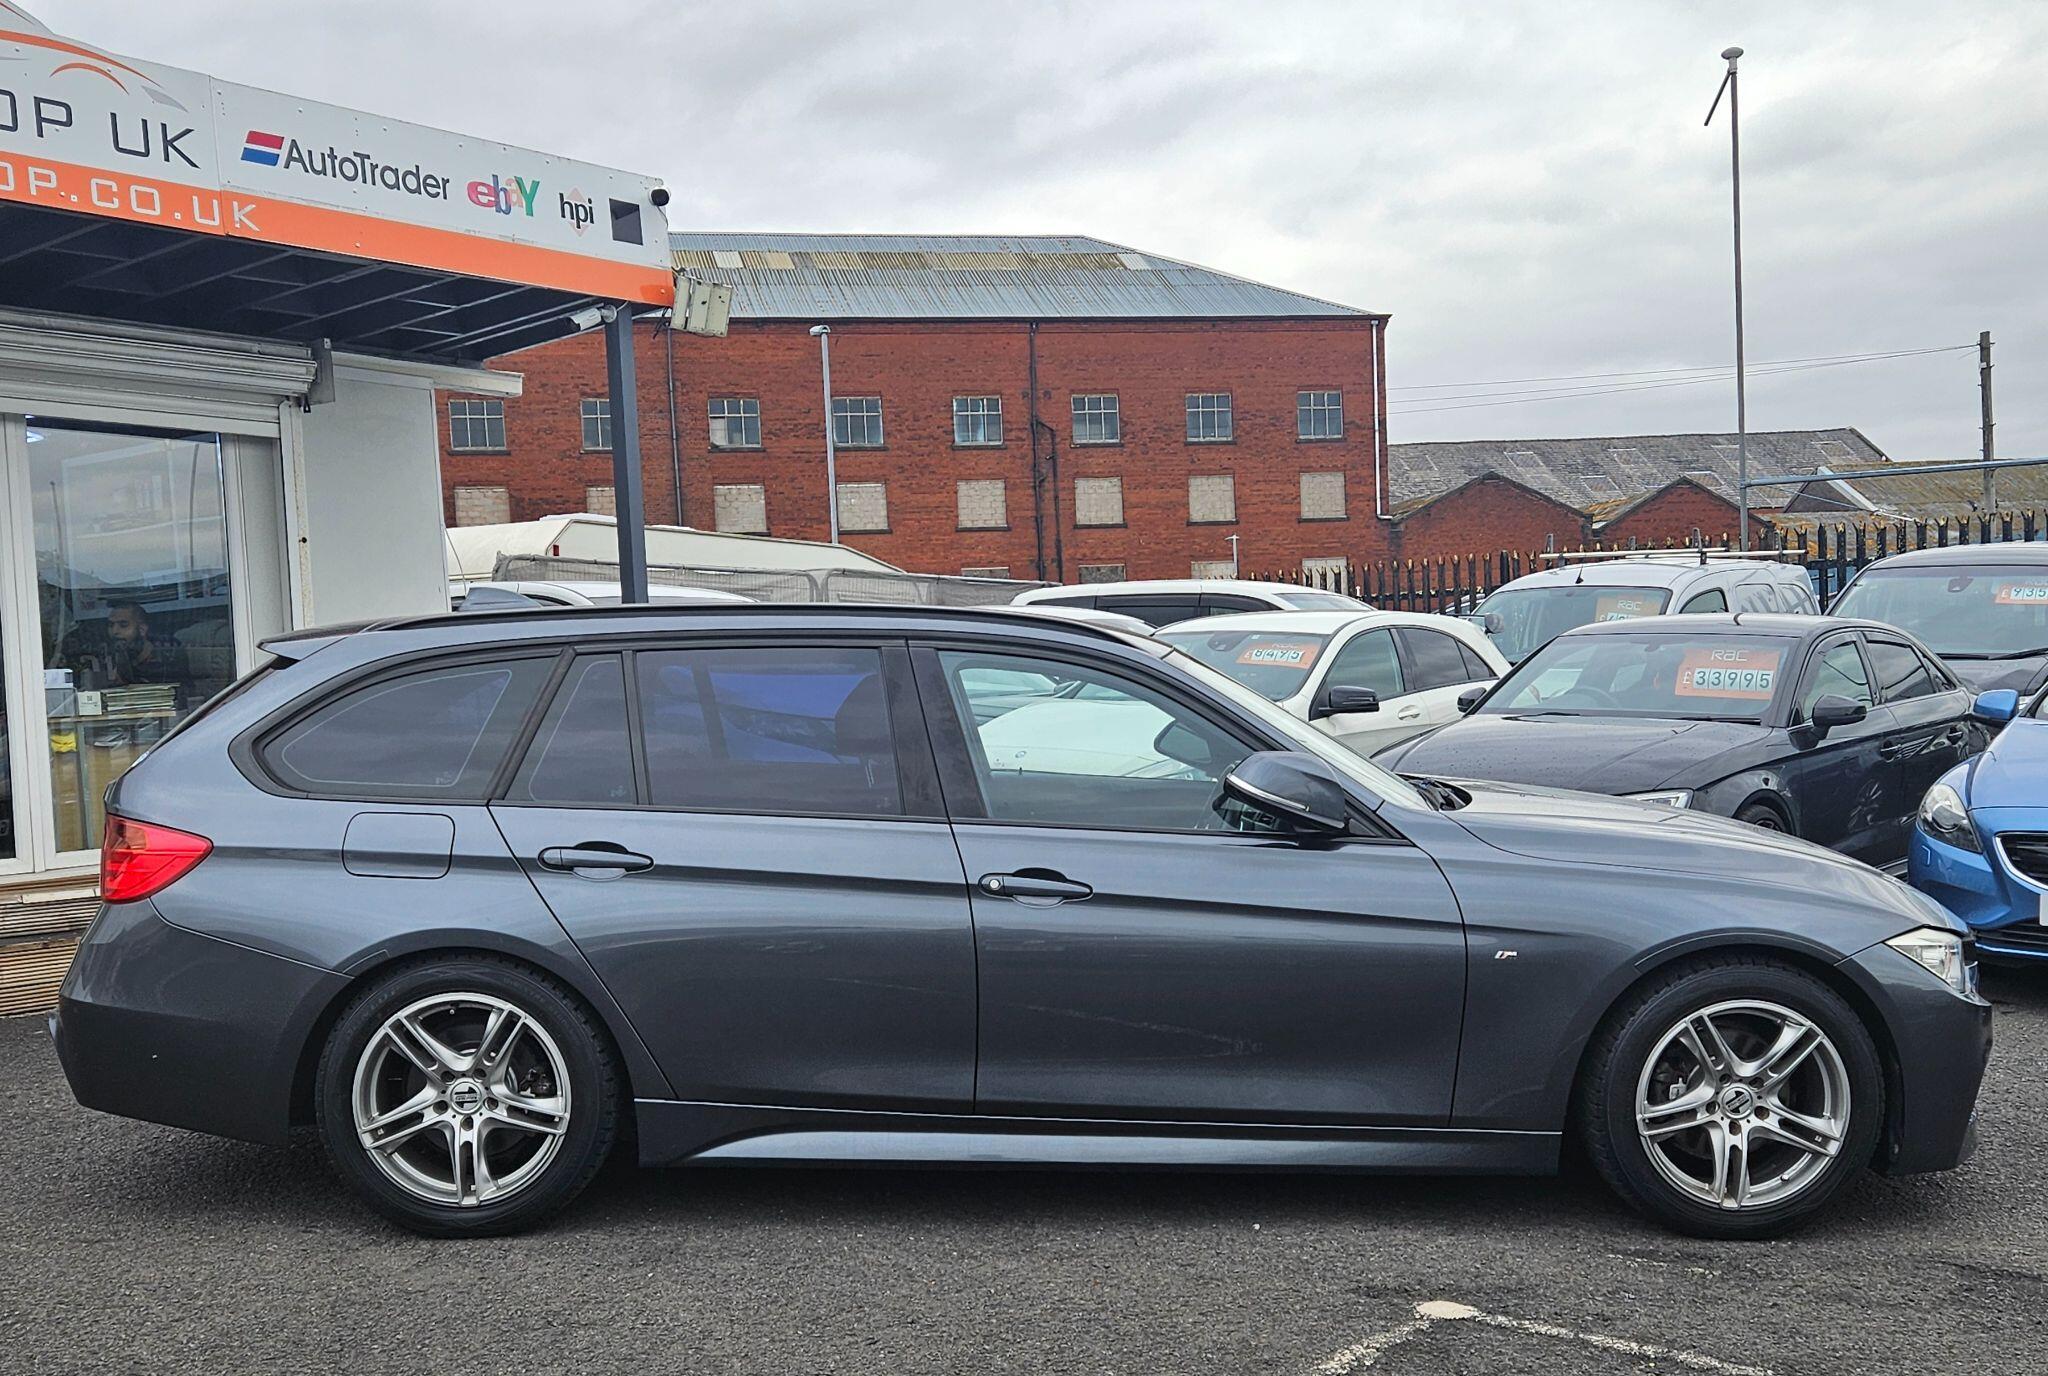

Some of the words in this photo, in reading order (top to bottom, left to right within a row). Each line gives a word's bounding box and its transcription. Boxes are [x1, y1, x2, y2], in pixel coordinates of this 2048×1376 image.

[110, 112, 201, 169] UK
[283, 139, 450, 200] AutoTrader
[559, 192, 594, 229] hpi
